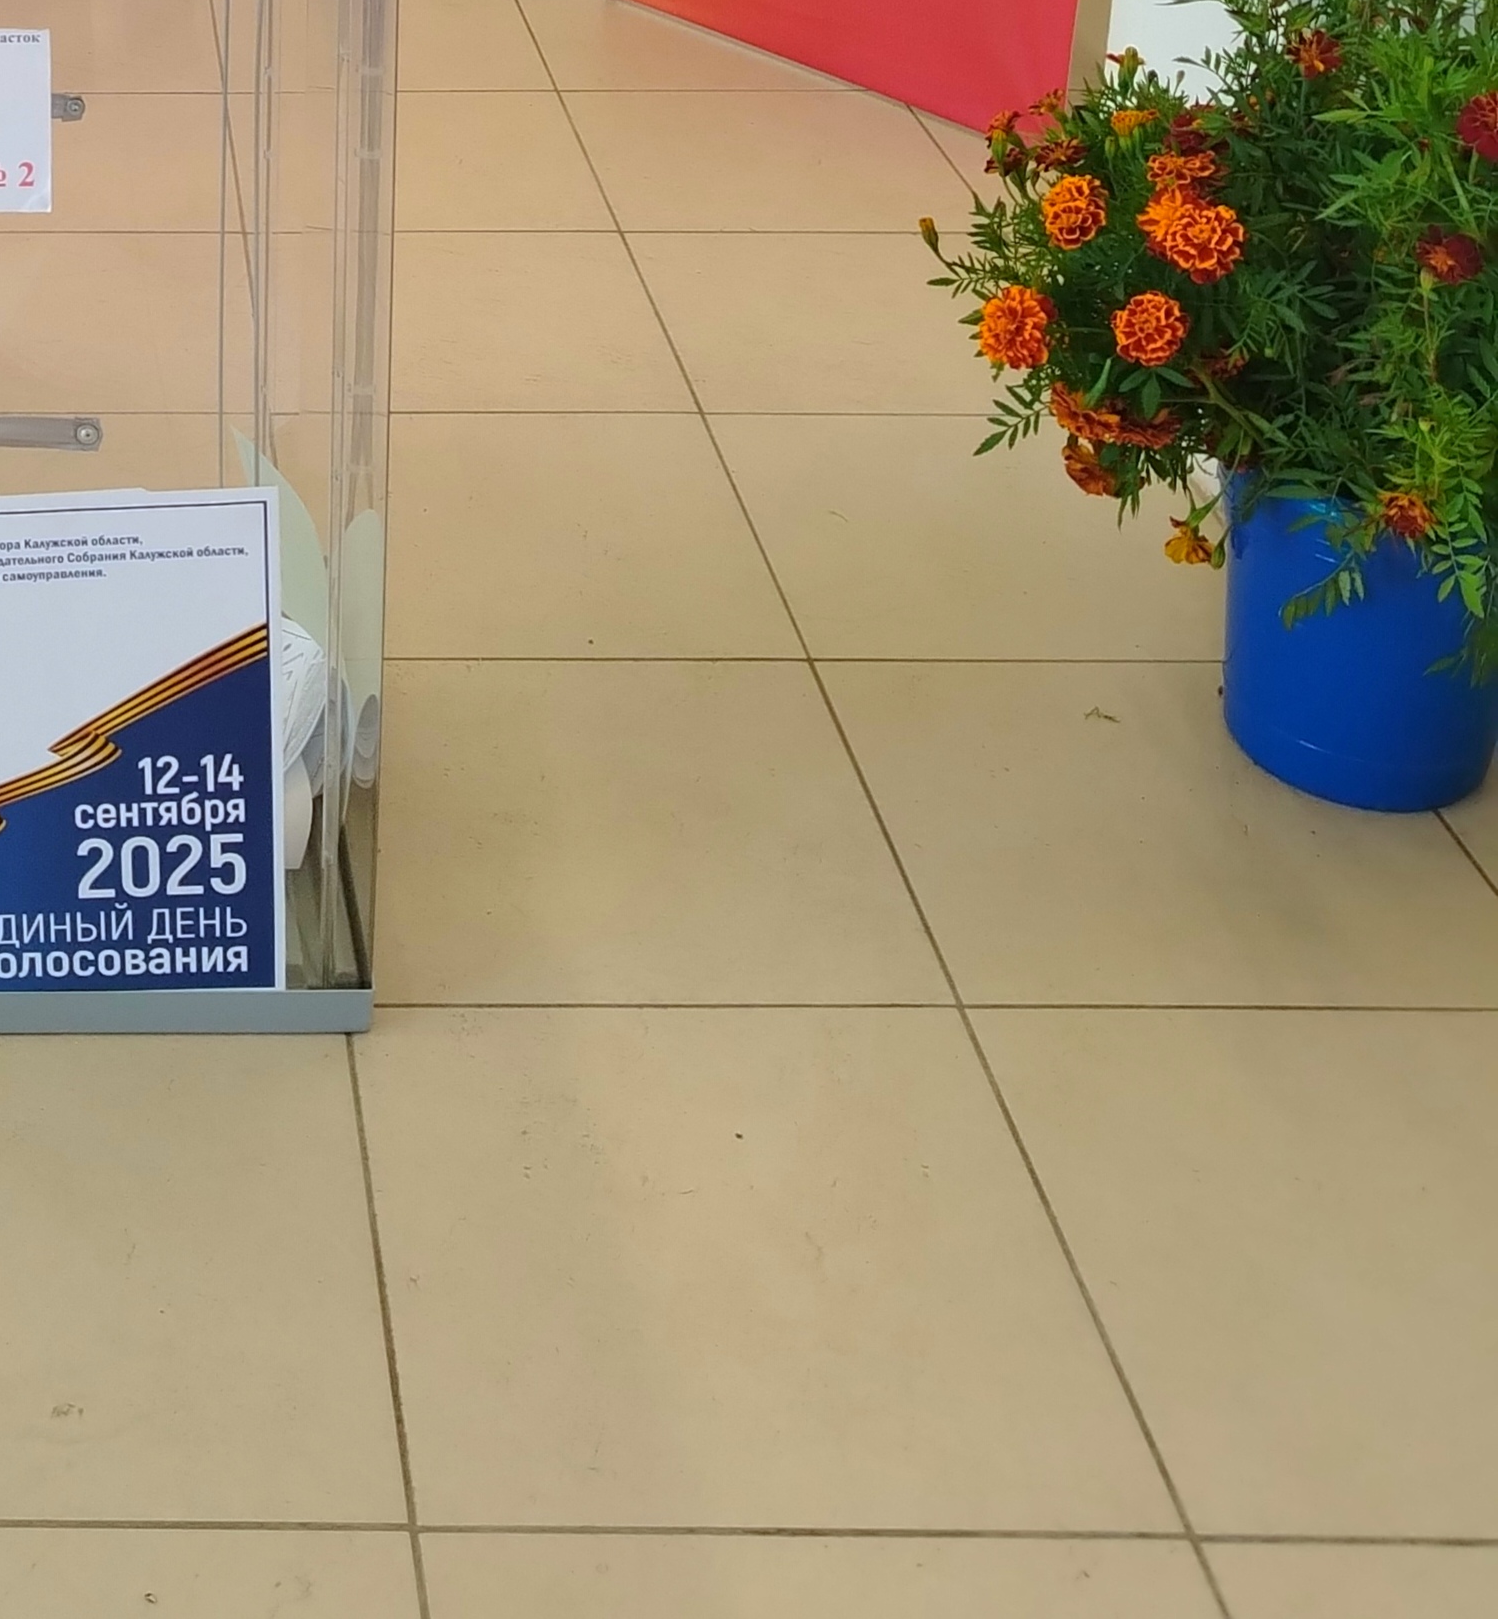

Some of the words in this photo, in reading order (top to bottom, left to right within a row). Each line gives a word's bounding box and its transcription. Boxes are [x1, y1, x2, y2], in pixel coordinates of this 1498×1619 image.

[18, 162, 35, 187] 2
[24, 537, 88, 551] Калужской
[91, 535, 143, 547] области,
[67, 550, 126, 564] Собрания
[129, 547, 193, 562] Калужской
[197, 545, 249, 558] области,
[2, 568, 107, 583] самоуправления.
[138, 753, 244, 795] 12-14
[74, 791, 246, 831] сентября
[76, 834, 247, 899] 2025
[147, 906, 248, 945] ДЕНЬ
